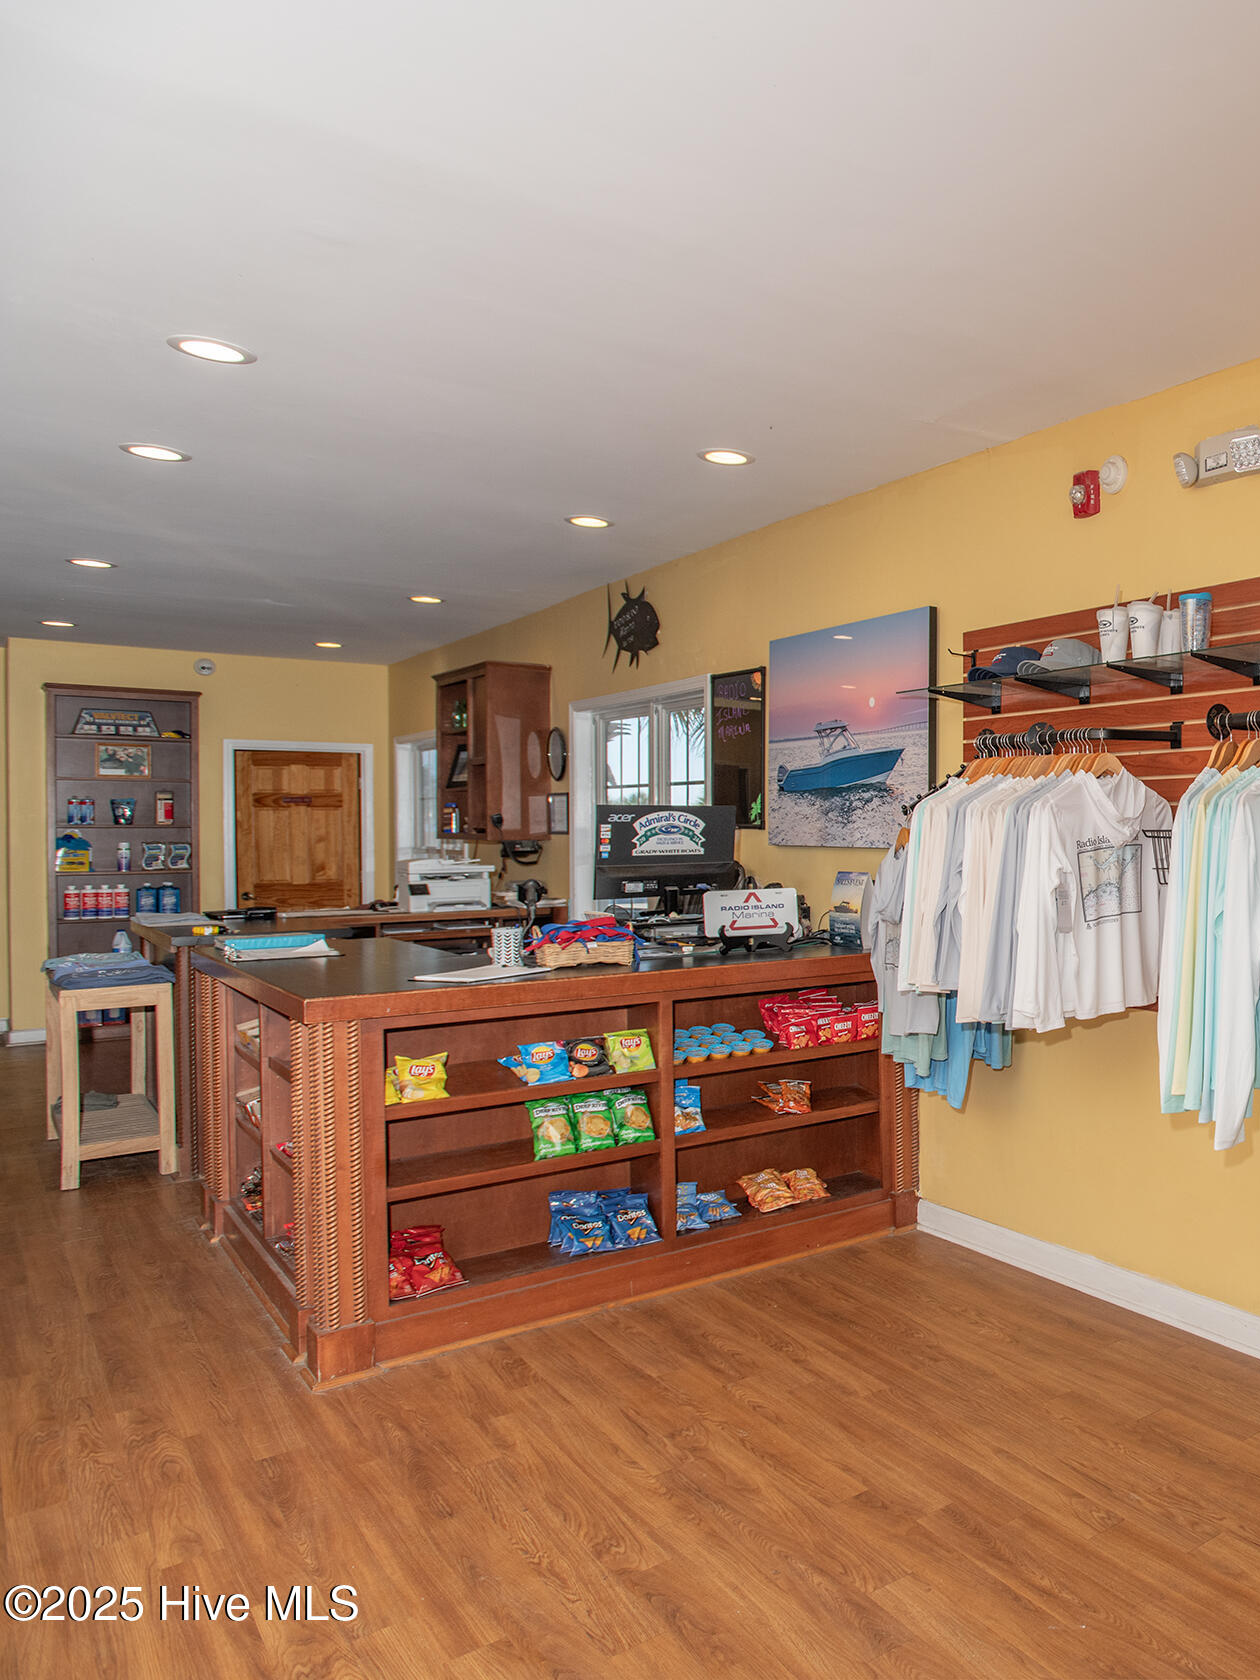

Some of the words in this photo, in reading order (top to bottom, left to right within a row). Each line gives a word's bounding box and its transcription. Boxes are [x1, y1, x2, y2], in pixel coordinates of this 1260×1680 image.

[608, 814, 636, 822] acer
[639, 812, 676, 830] Admiral's
[677, 814, 701, 830] Circle
[1076, 836, 1098, 850] Radio
[1098, 835, 1111, 846] Isla
[720, 904, 750, 912] RADIO
[751, 903, 785, 911] ISLAND
[732, 911, 775, 920] Marina
[622, 1037, 641, 1049] Lay's
[531, 1049, 554, 1062] Lay's
[576, 1047, 598, 1060] Lay's
[410, 1064, 436, 1077] Lay's
[617, 1209, 646, 1222] Doritos
[572, 1221, 603, 1230] Doritos
